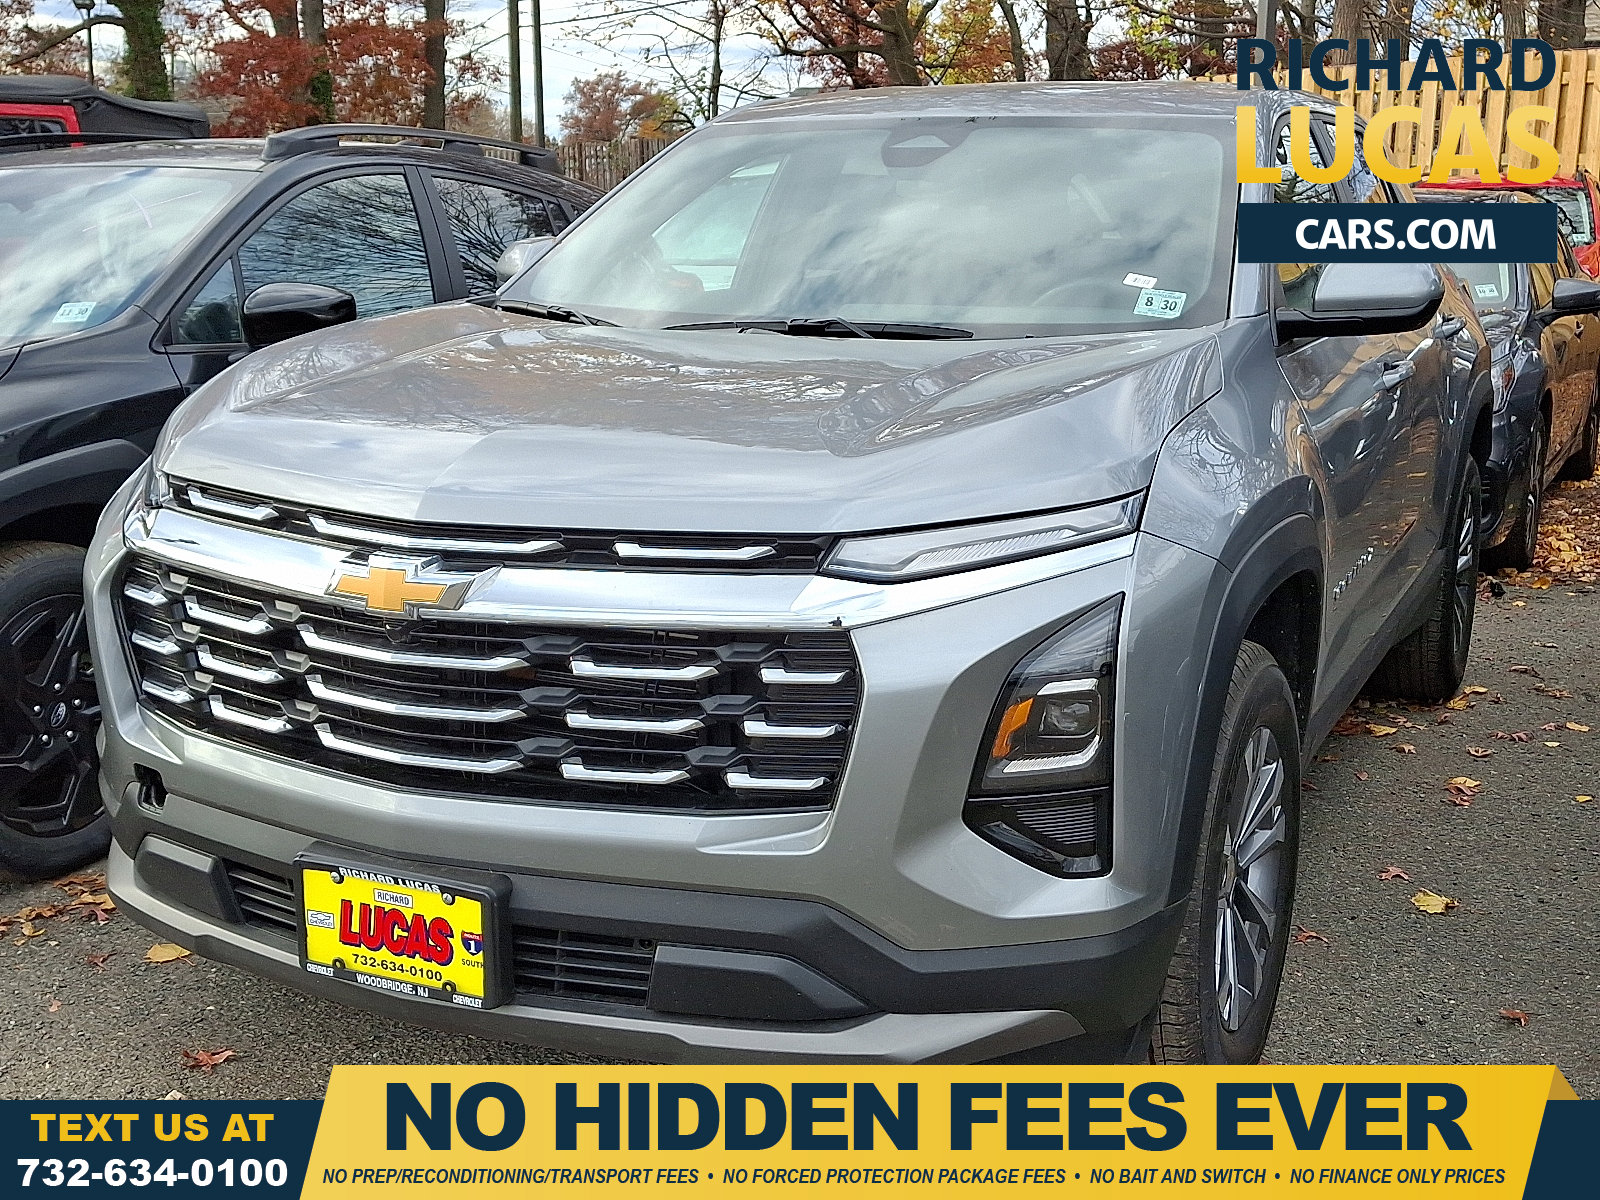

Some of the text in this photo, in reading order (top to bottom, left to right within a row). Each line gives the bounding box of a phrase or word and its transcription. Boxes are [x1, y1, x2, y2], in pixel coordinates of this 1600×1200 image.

[1145, 296, 1177, 311] 8 30
[339, 867, 441, 894] RICHARD LUCAS
[377, 891, 410, 906] RICHARD
[339, 899, 454, 967] LUCAS
[467, 940, 478, 954] 1
[352, 953, 443, 982] 732-634-0100
[417, 986, 429, 998] NJ
